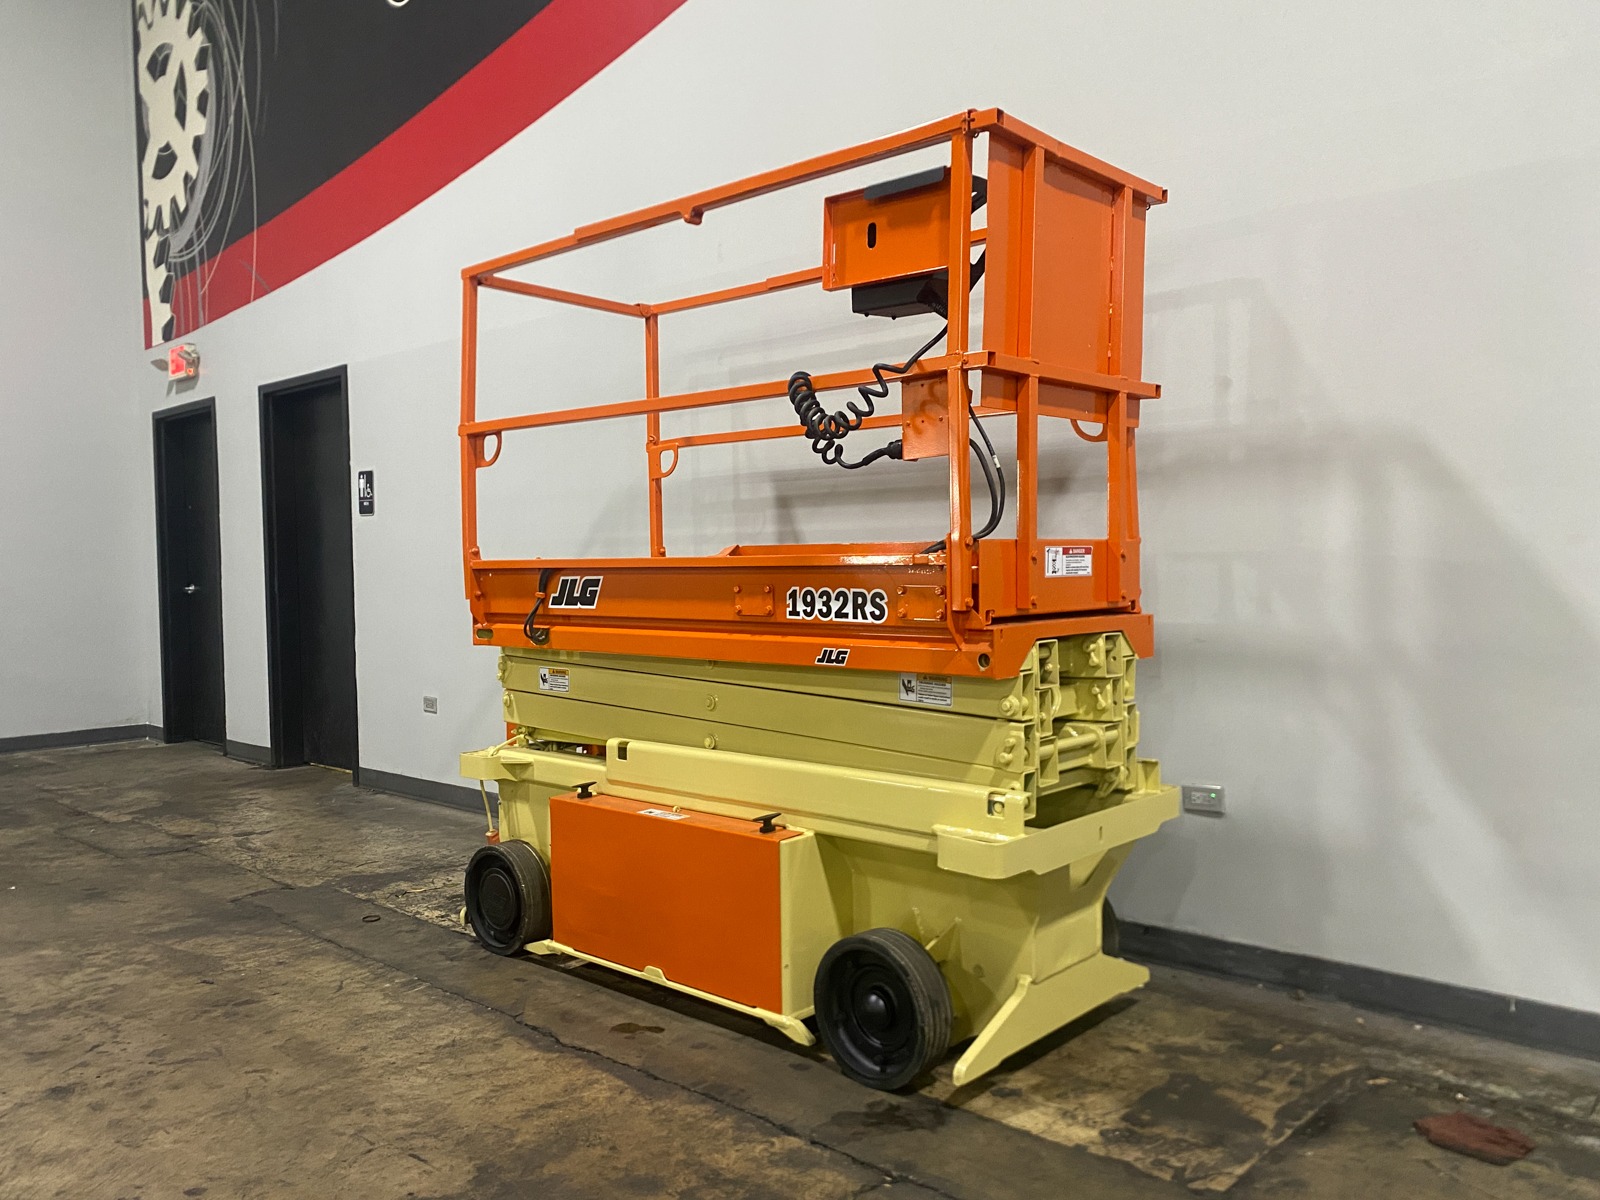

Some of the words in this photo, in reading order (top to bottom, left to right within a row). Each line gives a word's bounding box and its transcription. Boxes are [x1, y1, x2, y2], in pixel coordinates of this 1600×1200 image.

[549, 577, 602, 608] JLG
[787, 588, 887, 622] 1932RS
[816, 649, 849, 665] JLG
